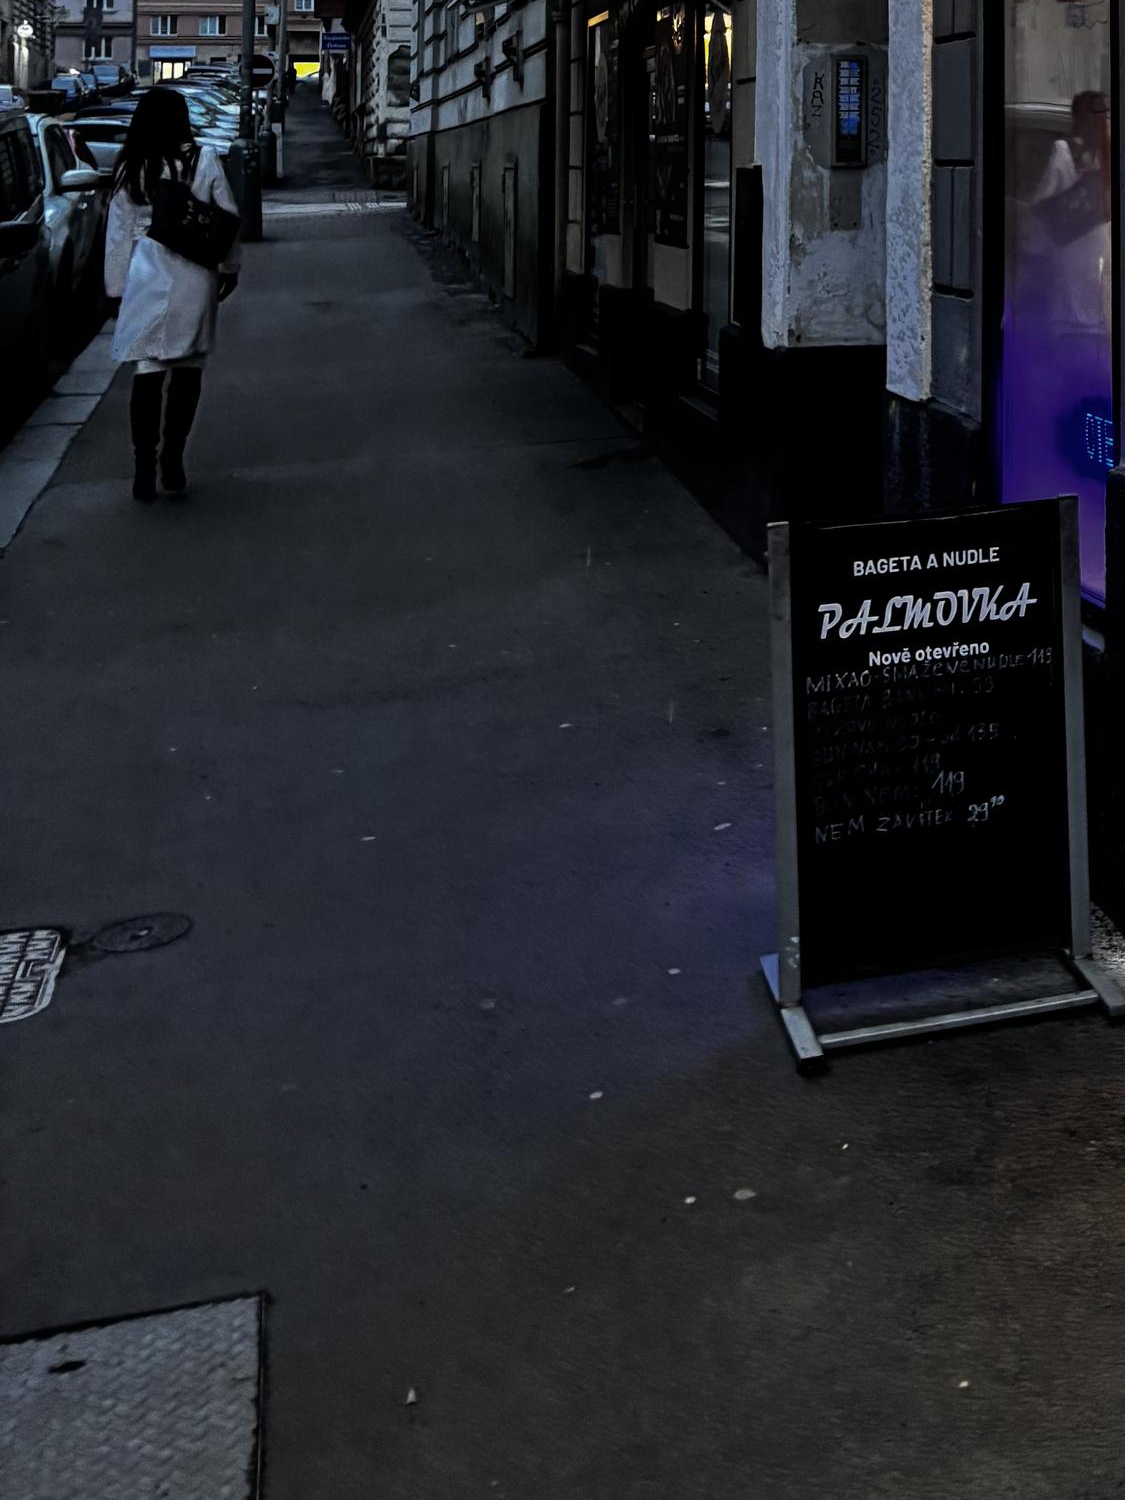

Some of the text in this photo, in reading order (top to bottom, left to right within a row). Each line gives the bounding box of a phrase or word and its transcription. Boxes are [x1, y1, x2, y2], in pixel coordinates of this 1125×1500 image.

[853, 546, 1000, 577] BAGETA A NUDLE
[817, 581, 1038, 640] PALMOVKA
[868, 641, 990, 667] Nově otevřeno
